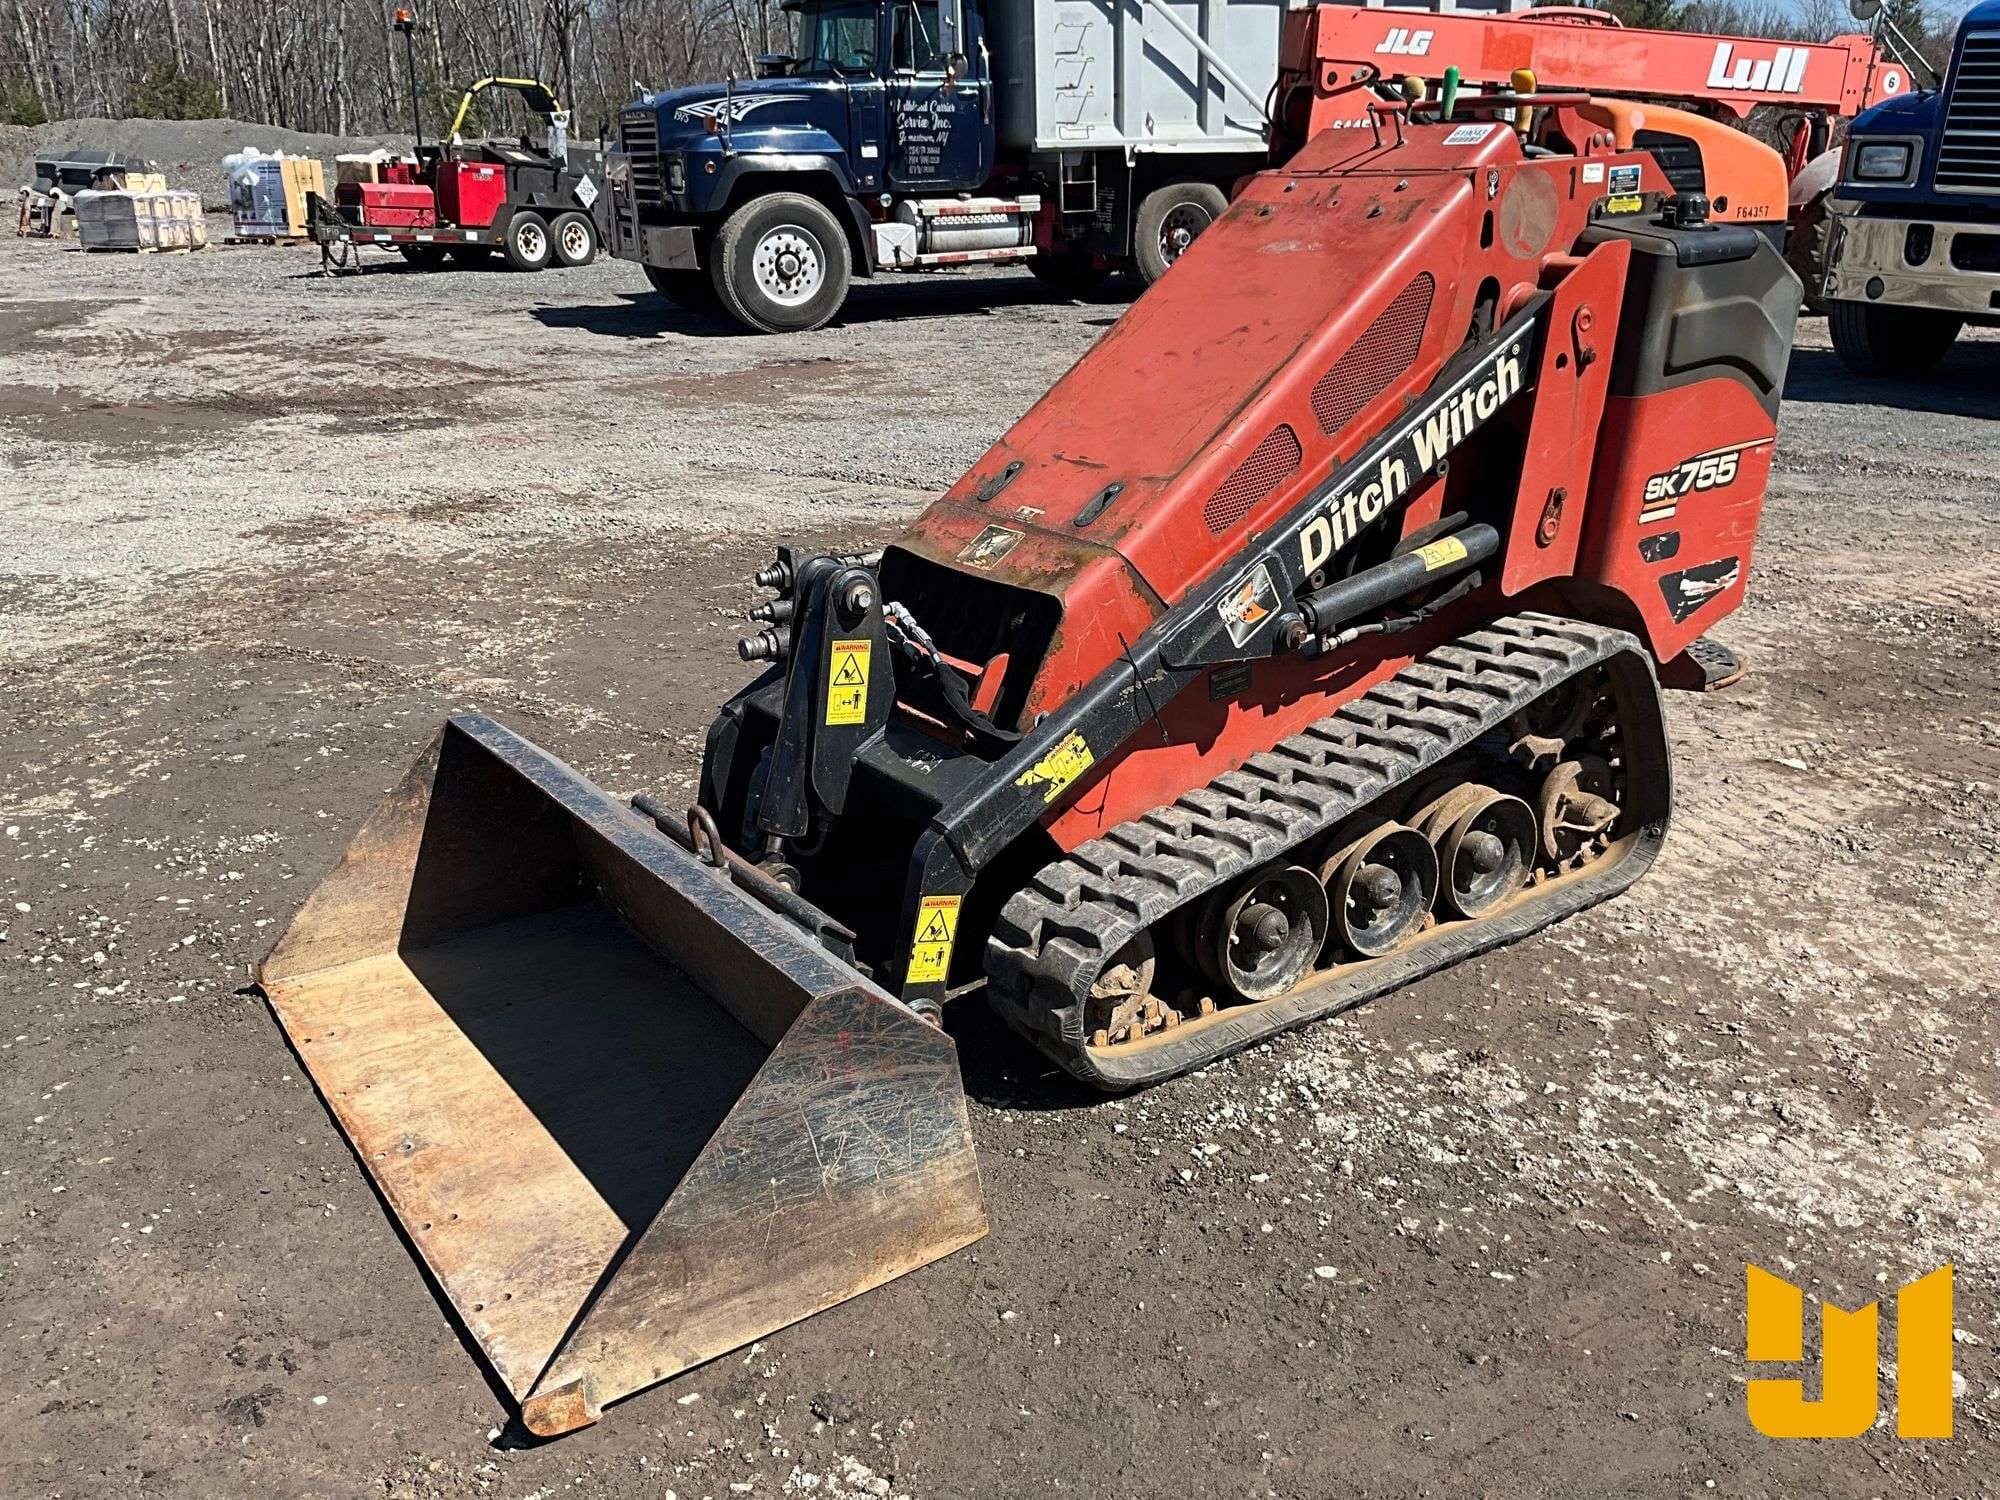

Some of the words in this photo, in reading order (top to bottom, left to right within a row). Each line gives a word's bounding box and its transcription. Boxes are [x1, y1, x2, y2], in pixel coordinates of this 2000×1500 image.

[1375, 28, 1434, 56] JLG
[1706, 42, 1809, 93] Lull
[1887, 77, 1896, 89] 6
[673, 110, 690, 123] 1975
[932, 113, 951, 131] Inc.
[1300, 456, 1407, 577] Ditch
[1411, 355, 1520, 474] Witch
[1644, 451, 1739, 501] SK755
[840, 643, 868, 651] WARNING
[930, 900, 958, 908] WARNING
